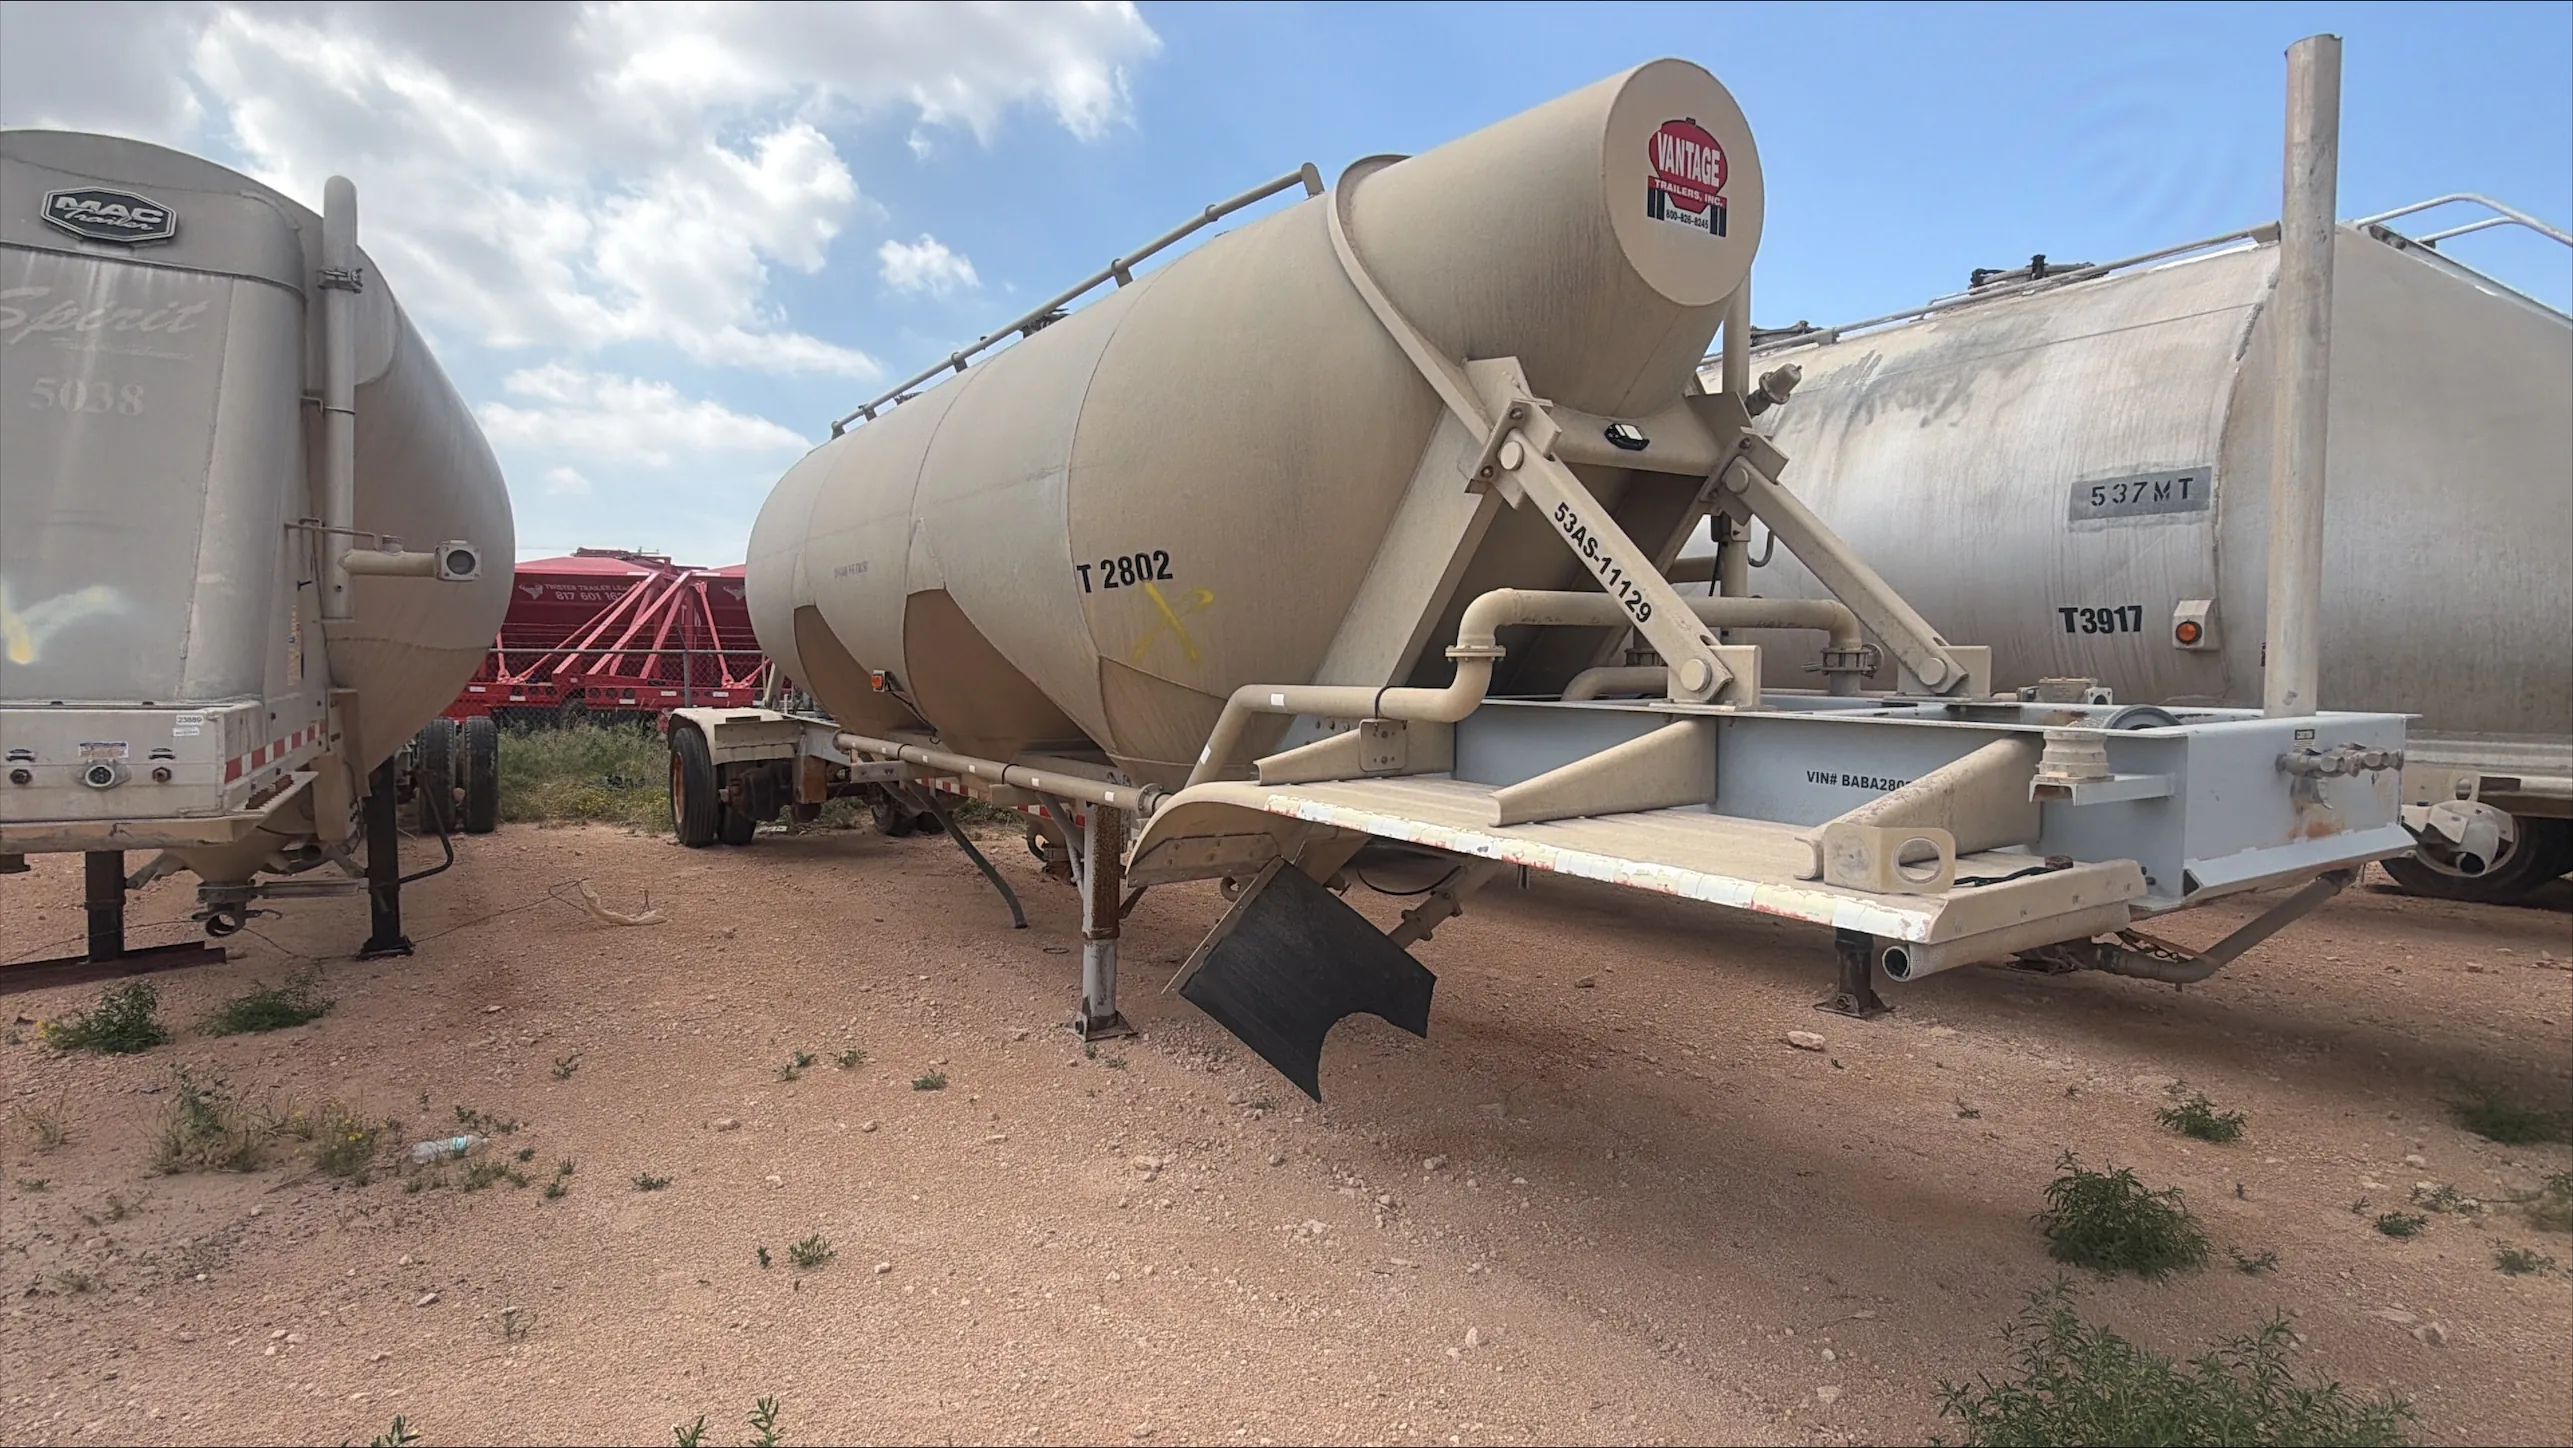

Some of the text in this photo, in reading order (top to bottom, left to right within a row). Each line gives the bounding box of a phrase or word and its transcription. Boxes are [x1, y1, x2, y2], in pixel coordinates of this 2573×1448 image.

[1657, 131, 1721, 187] VANTAGE
[1654, 179, 1724, 207] TRAILERS, INC.
[55, 196, 163, 223] MAC
[64, 209, 154, 230] Trailer
[0, 286, 210, 345] Spirit
[27, 378, 144, 416] 5038
[1076, 550, 1173, 593] T 2802
[1554, 502, 1652, 623] 53AS-11129
[555, 591, 575, 600] 817
[580, 592, 601, 601] 601
[2059, 605, 2142, 634] T3917
[1806, 770, 1912, 791] VIN# BABA280
